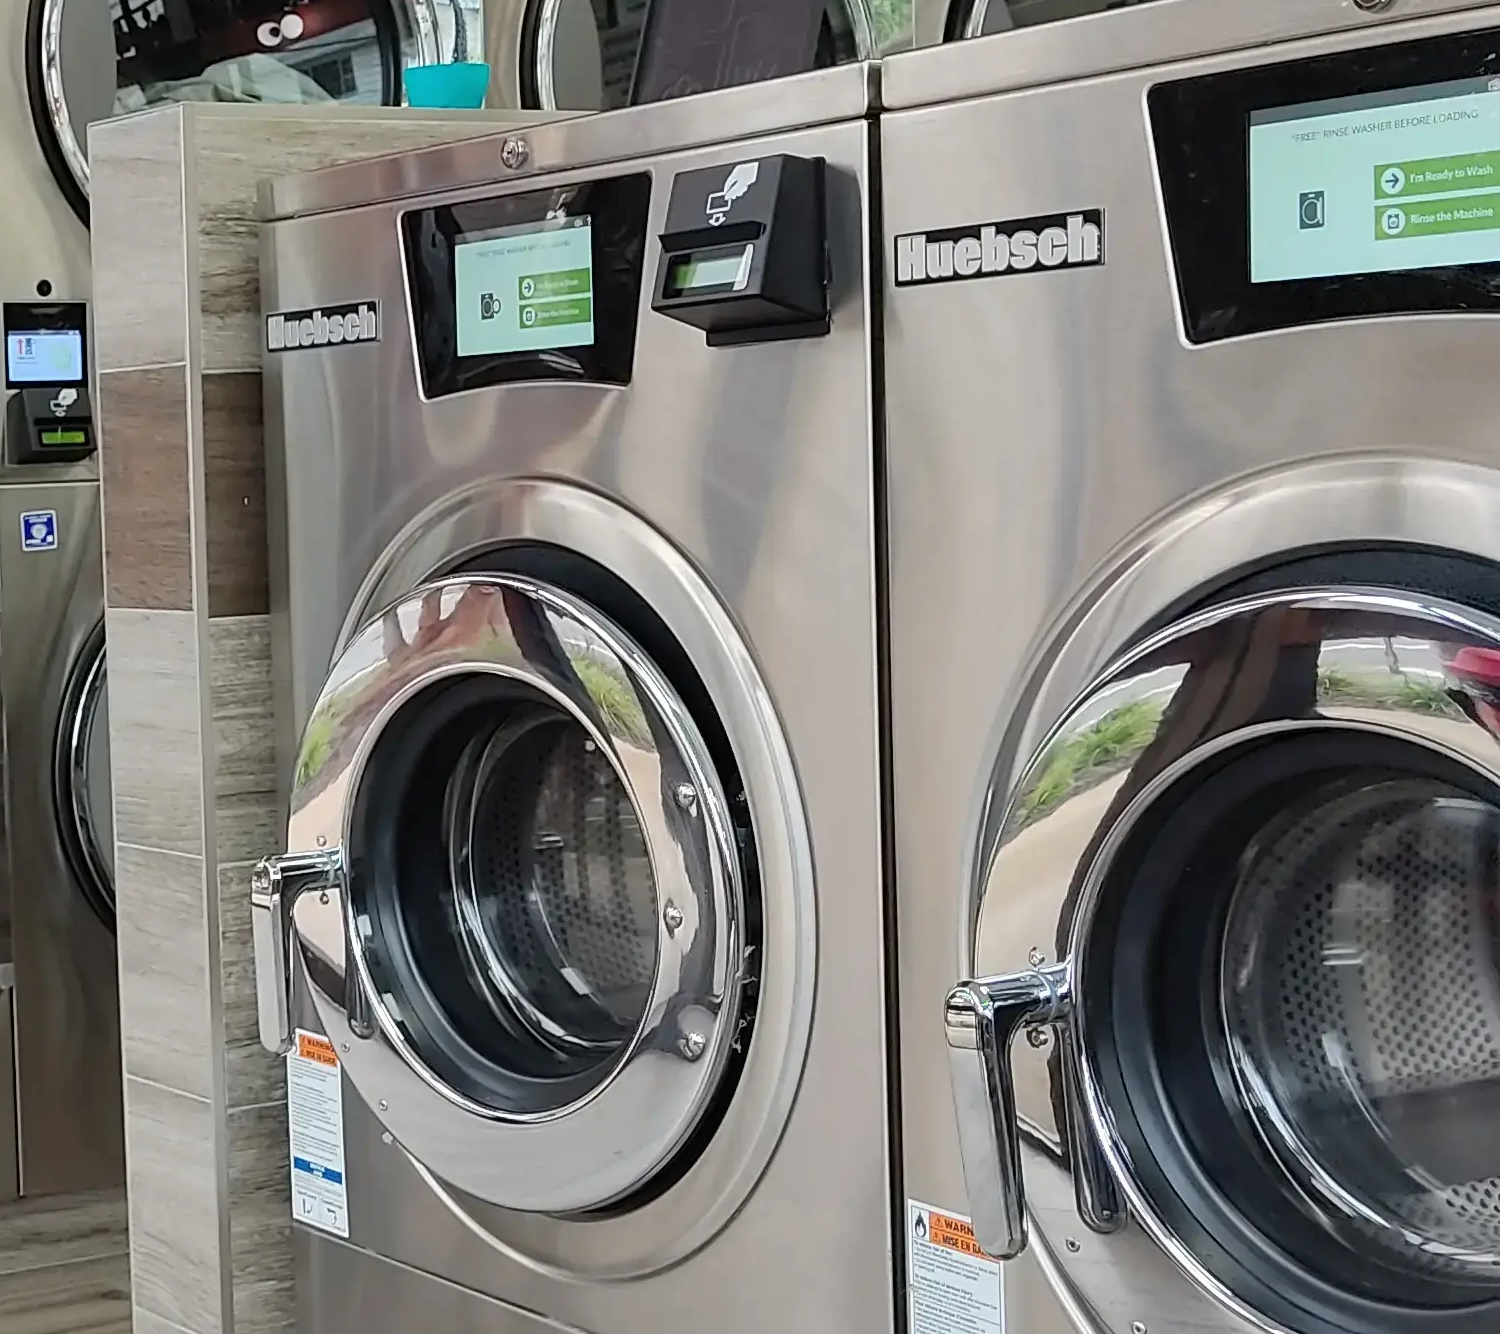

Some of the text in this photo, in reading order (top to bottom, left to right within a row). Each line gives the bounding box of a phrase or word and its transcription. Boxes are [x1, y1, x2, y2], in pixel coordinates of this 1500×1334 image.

[1323, 126, 1349, 139] RINSE
[1351, 120, 1393, 135] WASHER
[1394, 115, 1431, 129] BEFORE
[1432, 109, 1480, 125] LOADING
[1410, 164, 1494, 184] I'm Ready to Wash
[1410, 207, 1494, 224] Rinse the Machine
[896, 213, 1101, 282] Huebsch
[267, 304, 377, 350] Huebsch
[944, 1218, 975, 1237] WARN
[942, 1233, 960, 1248] MISE
[960, 1239, 971, 1252] EN
